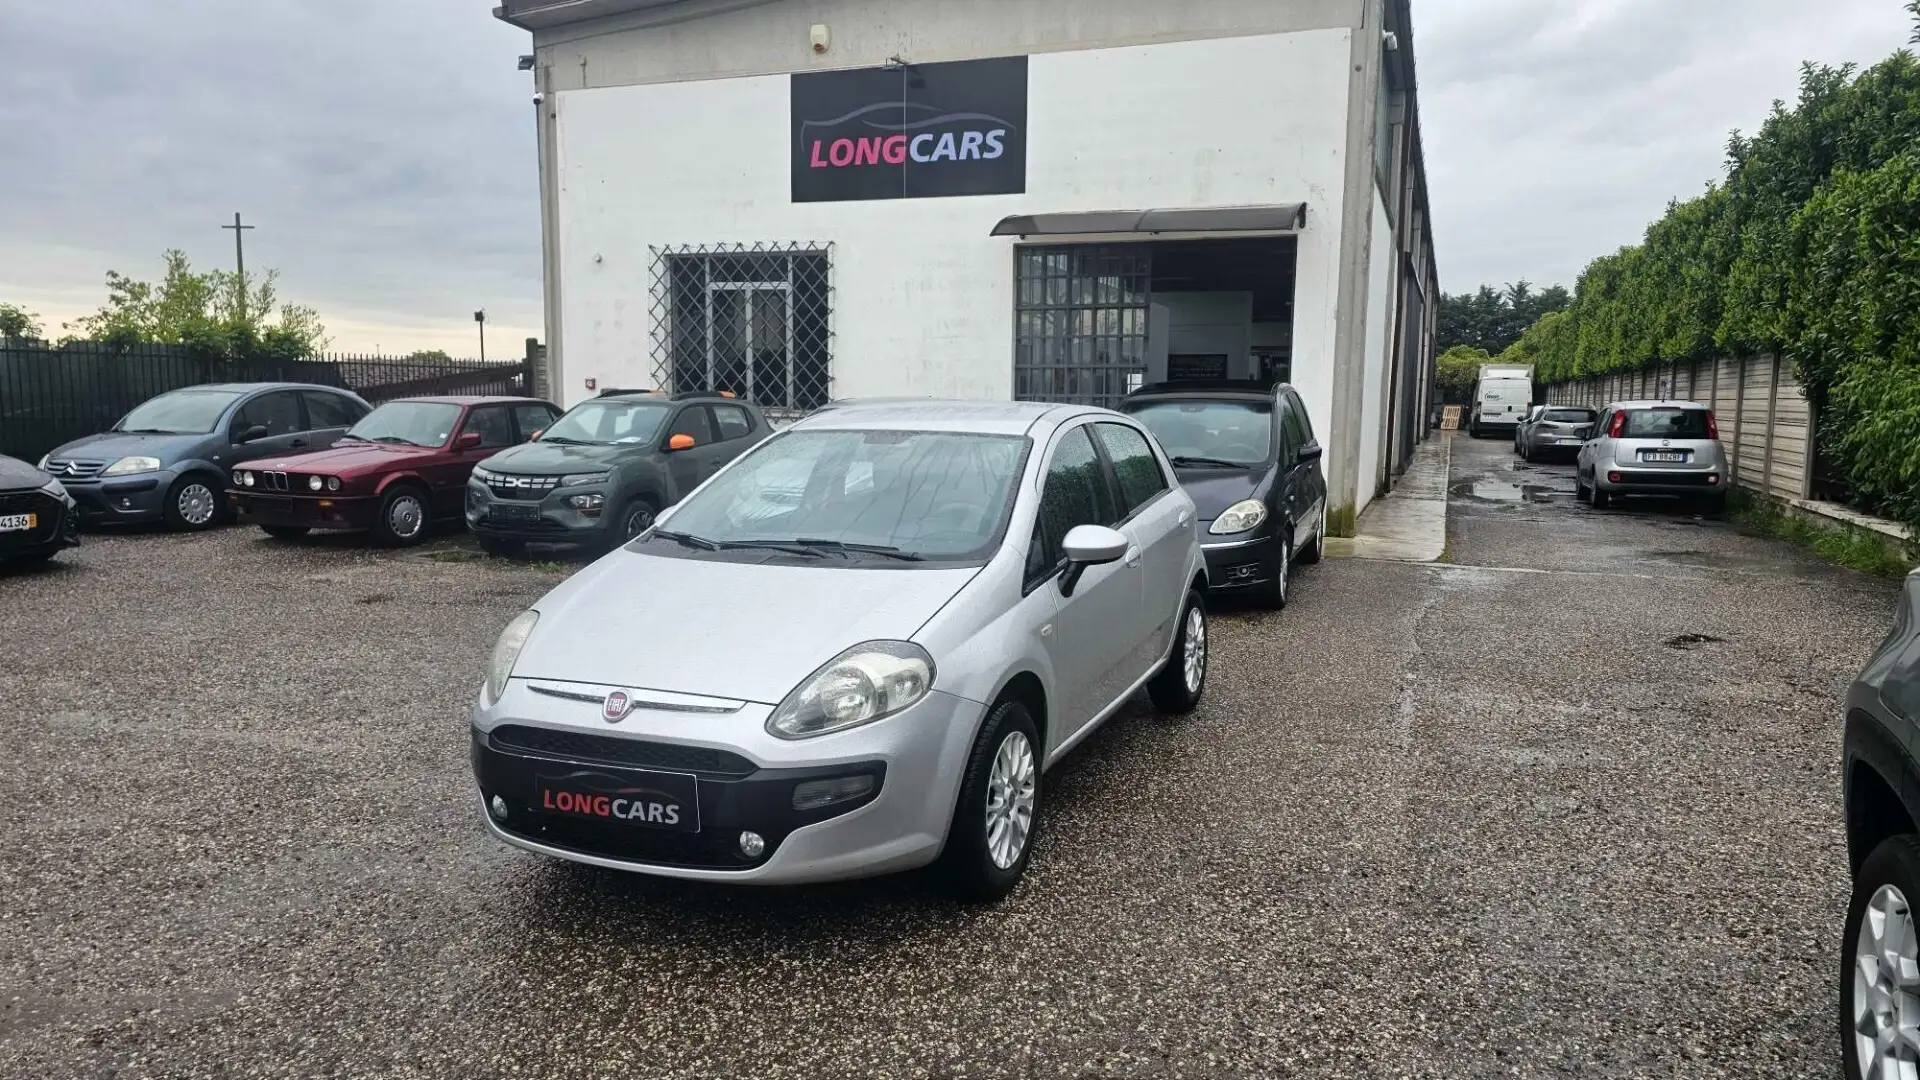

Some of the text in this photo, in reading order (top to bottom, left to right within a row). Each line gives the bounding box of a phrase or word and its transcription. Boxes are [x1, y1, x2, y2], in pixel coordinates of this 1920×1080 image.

[810, 129, 1006, 168] LONGCARS
[0, 515, 28, 528] 4136
[607, 698, 625, 712] FIAT
[543, 788, 680, 825] LONGCARS
